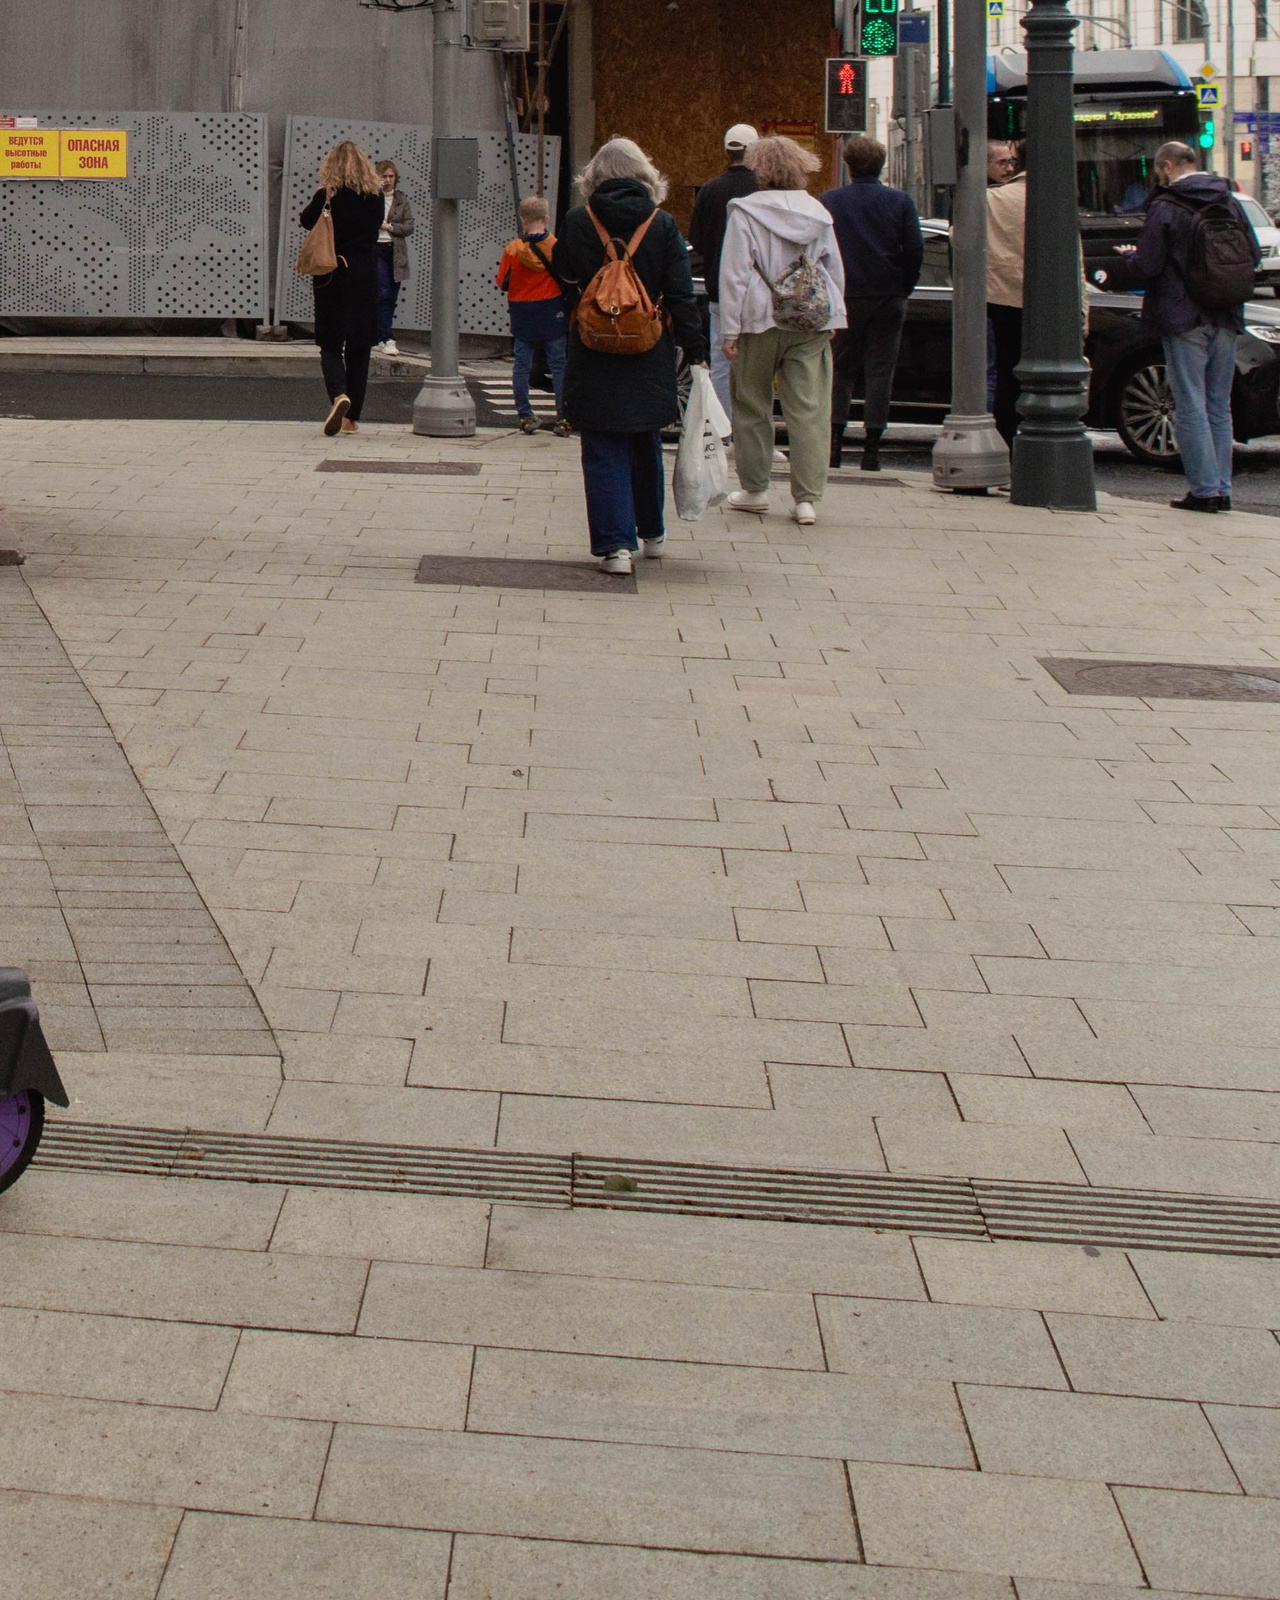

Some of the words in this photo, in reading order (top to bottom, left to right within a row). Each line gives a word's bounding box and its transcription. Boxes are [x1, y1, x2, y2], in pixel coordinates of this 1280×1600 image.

[8, 136, 44, 146] ВЕДУТСЯ
[67, 139, 120, 152] ОПАСНАЯ
[5, 149, 47, 157] высотные
[10, 160, 42, 170] работы
[78, 156, 109, 169] ЗОНА
